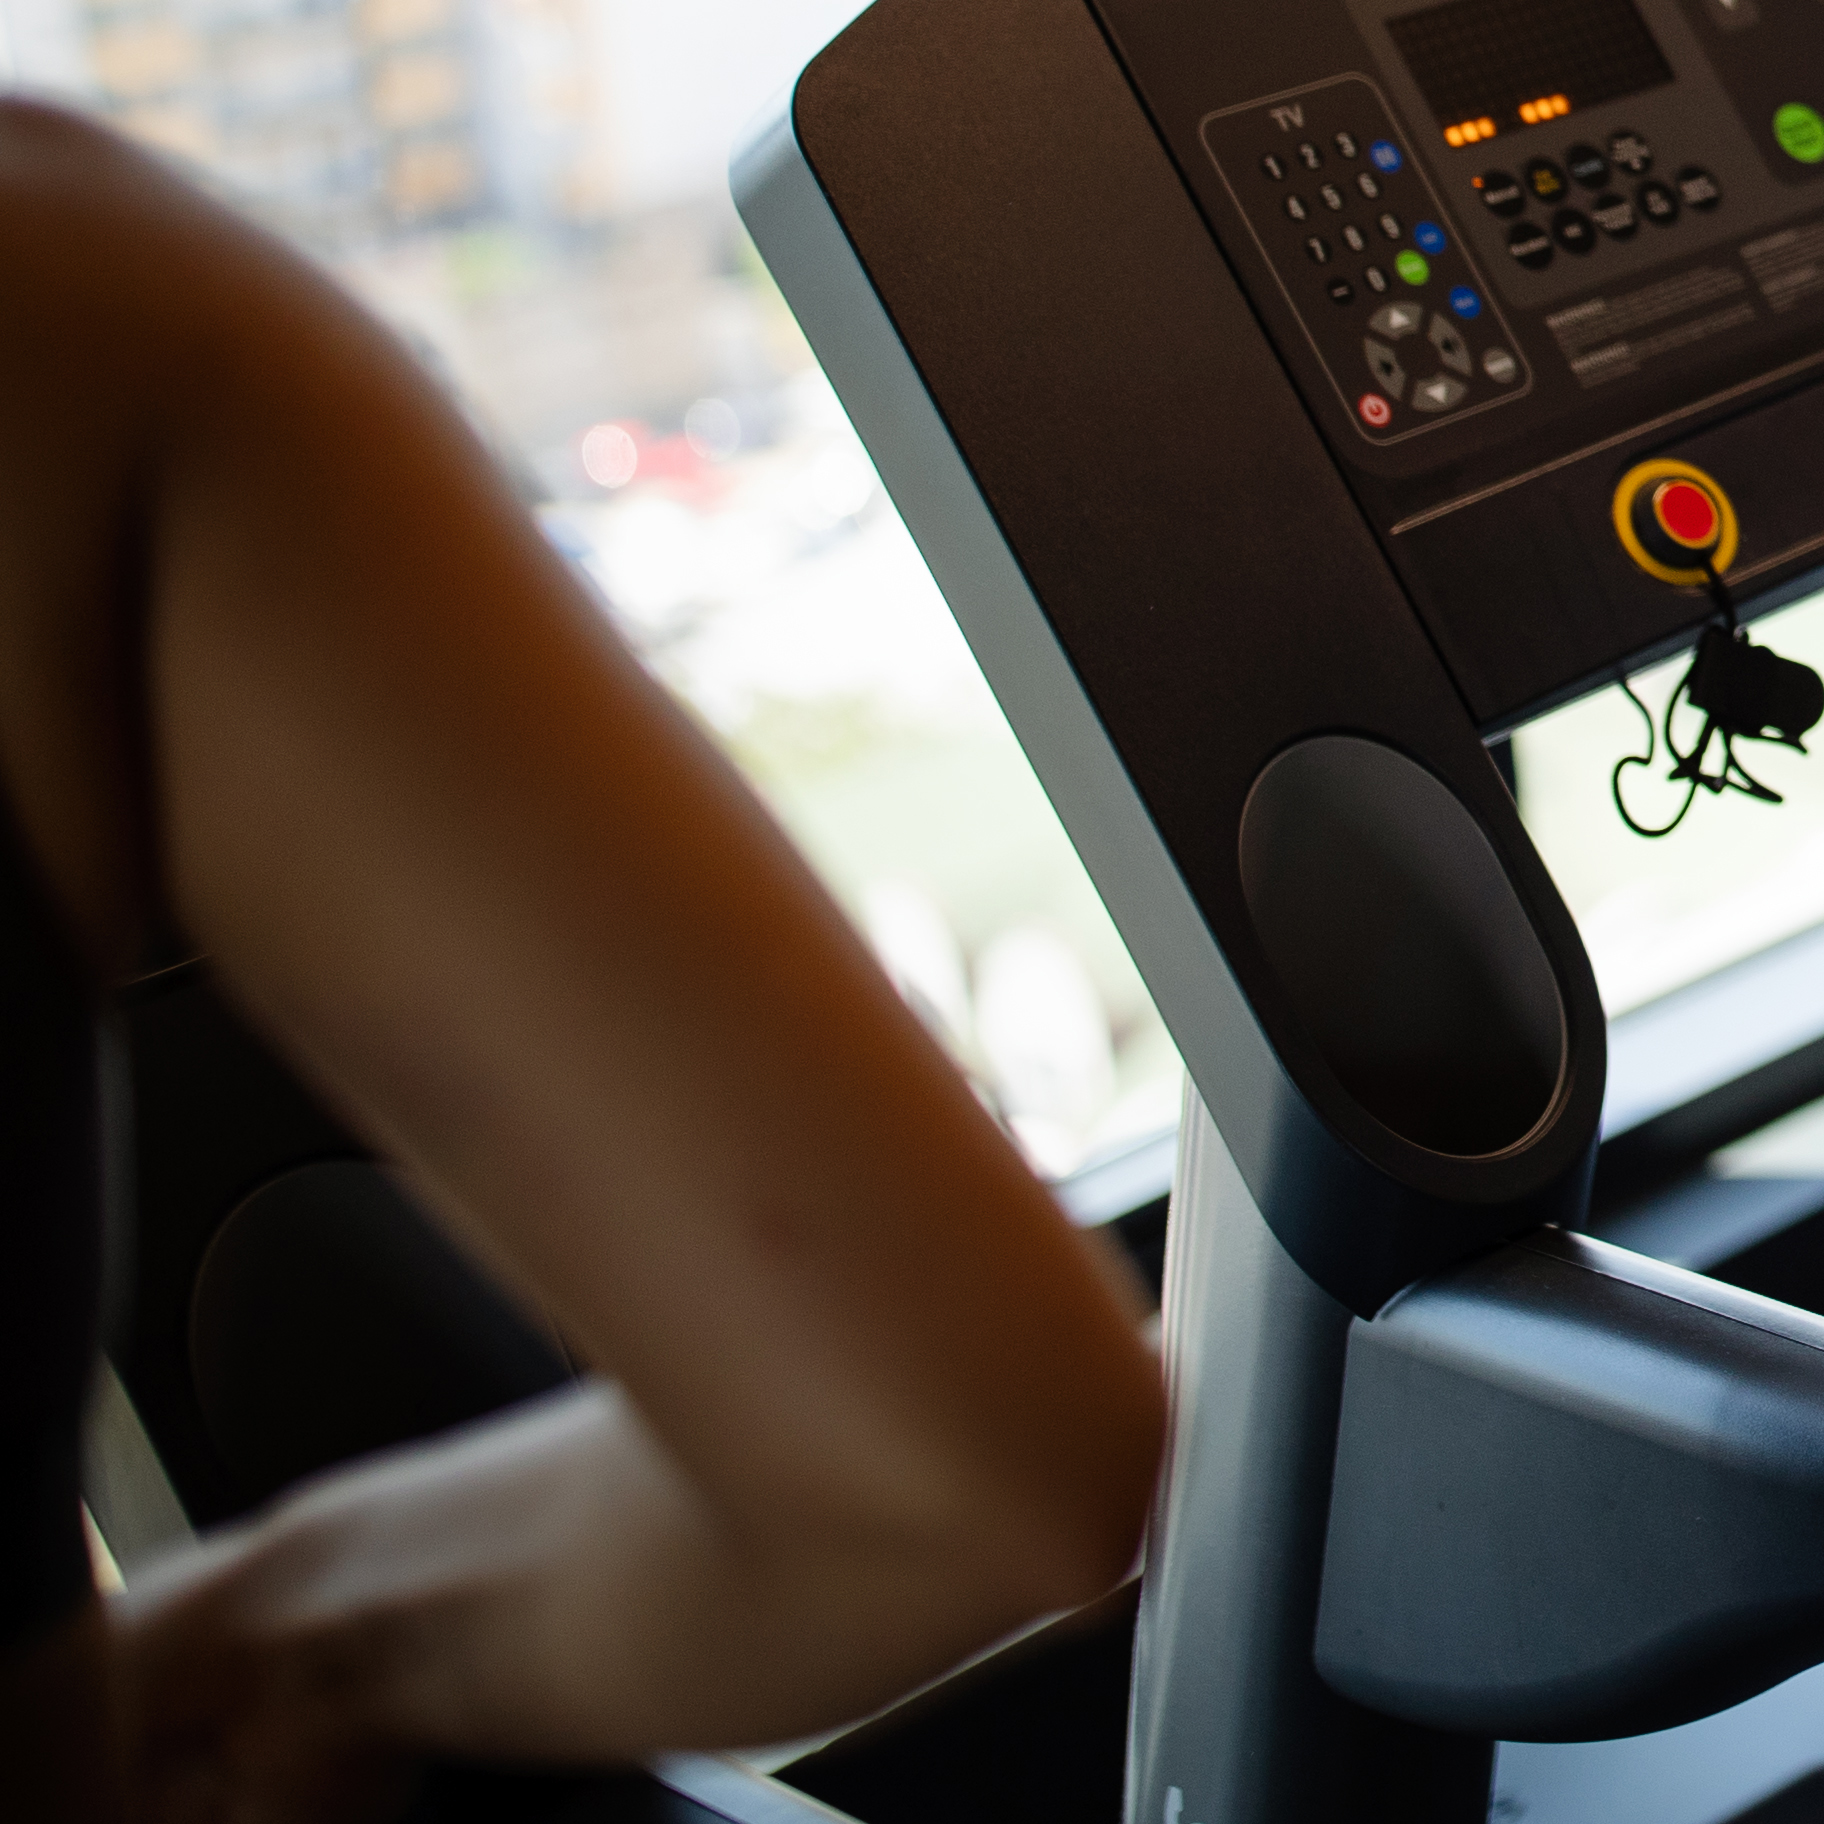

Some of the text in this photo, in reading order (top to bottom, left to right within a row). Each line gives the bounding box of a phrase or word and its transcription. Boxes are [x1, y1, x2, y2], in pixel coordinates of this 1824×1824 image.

[1269, 103, 1304, 131] TV
[1264, 155, 1282, 179] 1
[1301, 143, 1319, 169] 2
[1336, 132, 1356, 158] 3
[1287, 196, 1305, 220] 4
[1320, 184, 1342, 210] 5
[1308, 237, 1326, 262] 7
